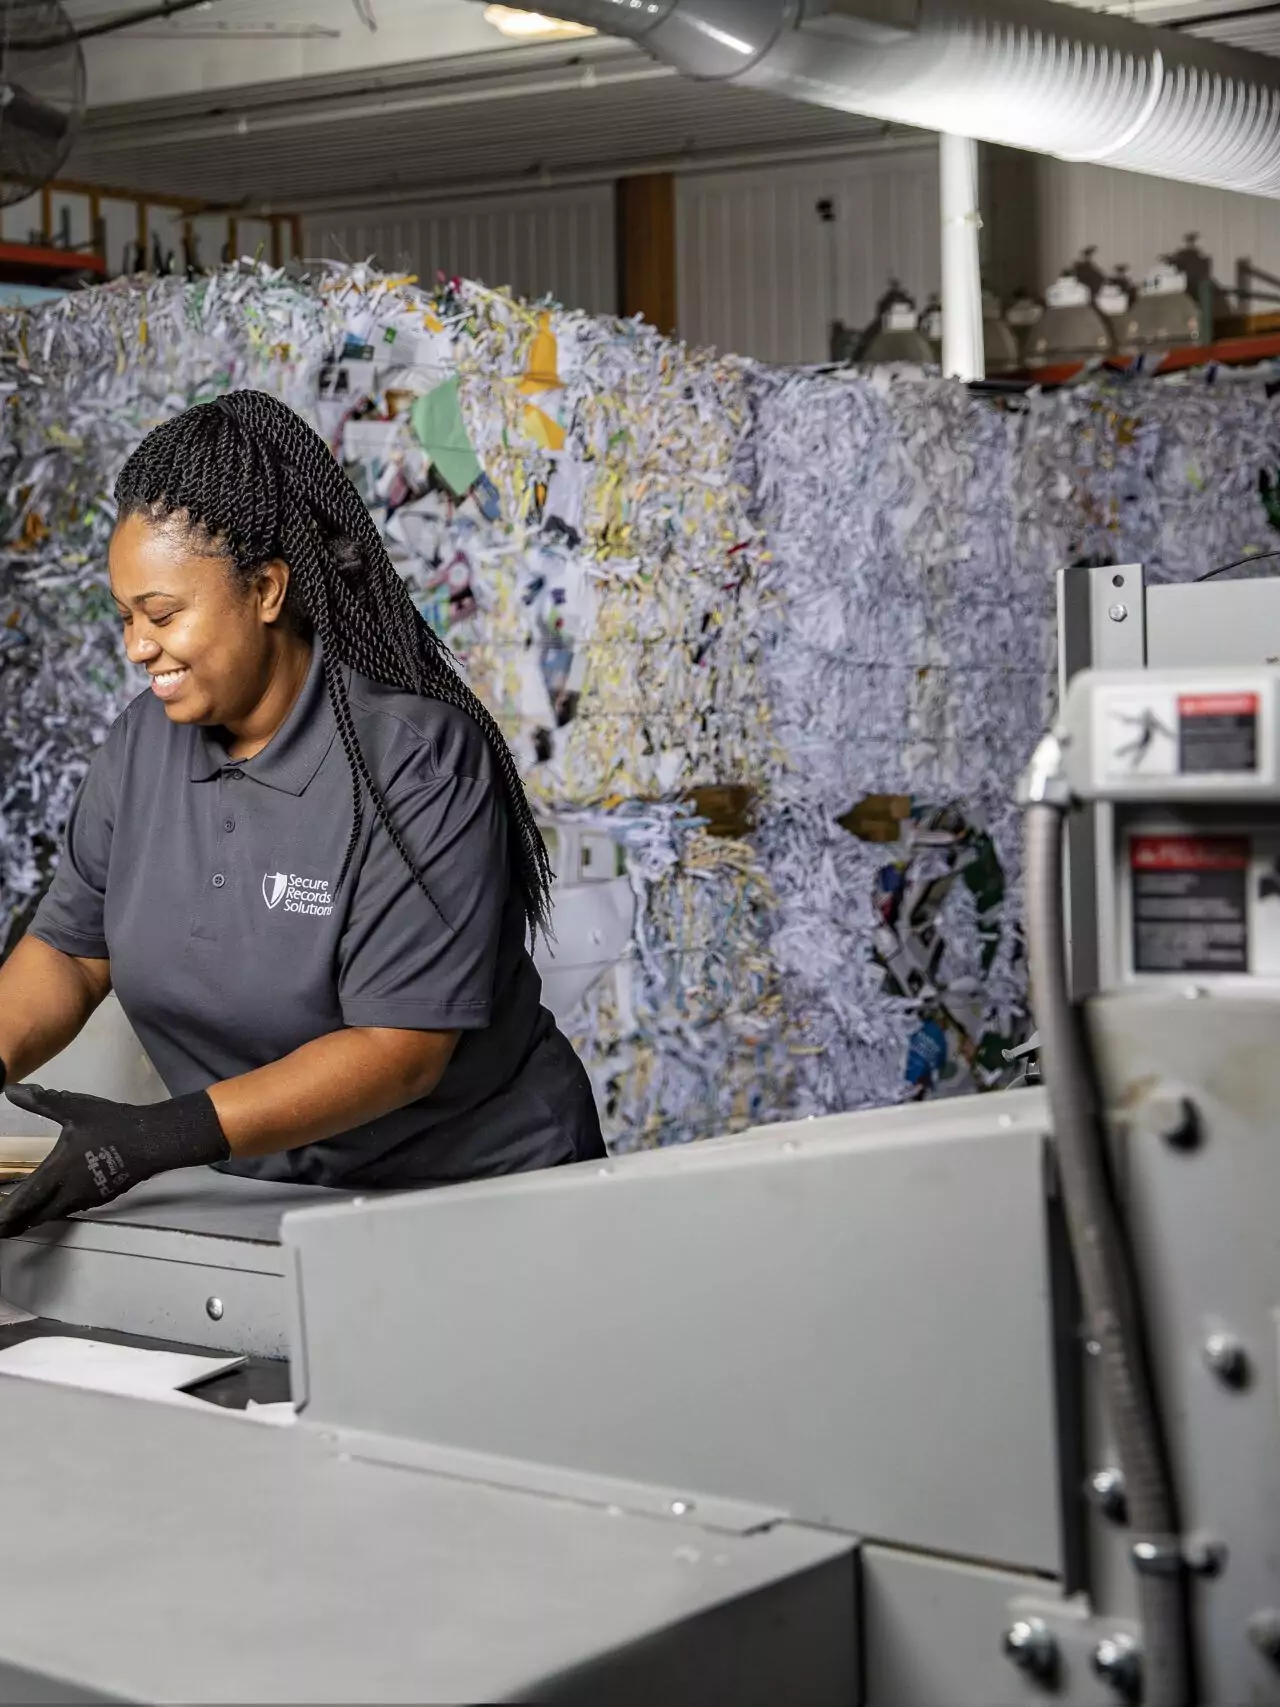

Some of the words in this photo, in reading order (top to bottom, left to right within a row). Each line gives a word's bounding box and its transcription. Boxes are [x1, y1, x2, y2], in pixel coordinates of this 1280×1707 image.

[288, 873, 329, 890] Secure
[286, 886, 331, 903] Records
[284, 899, 333, 916] Solutions
